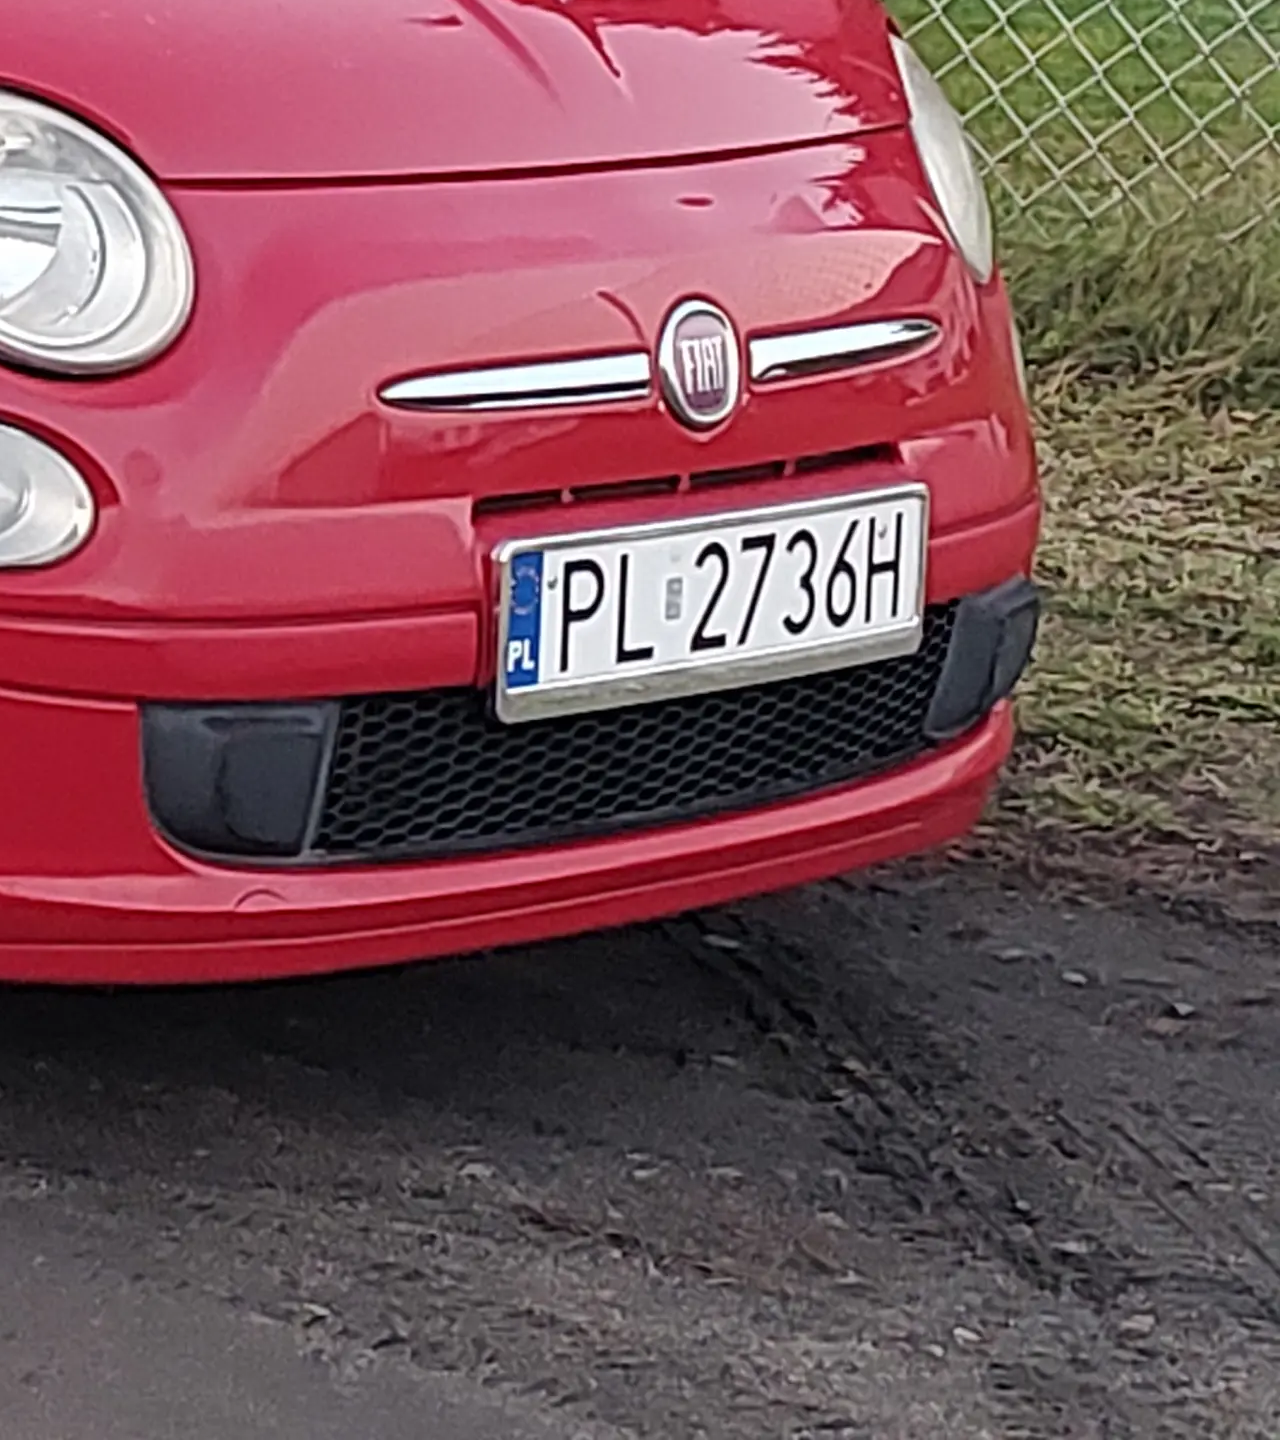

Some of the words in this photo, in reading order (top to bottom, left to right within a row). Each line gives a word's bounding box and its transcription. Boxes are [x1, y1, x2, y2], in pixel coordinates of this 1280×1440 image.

[679, 334, 727, 394] FIAT
[559, 553, 654, 673] PL
[689, 511, 903, 652] 2736H
[507, 639, 536, 673] PL
